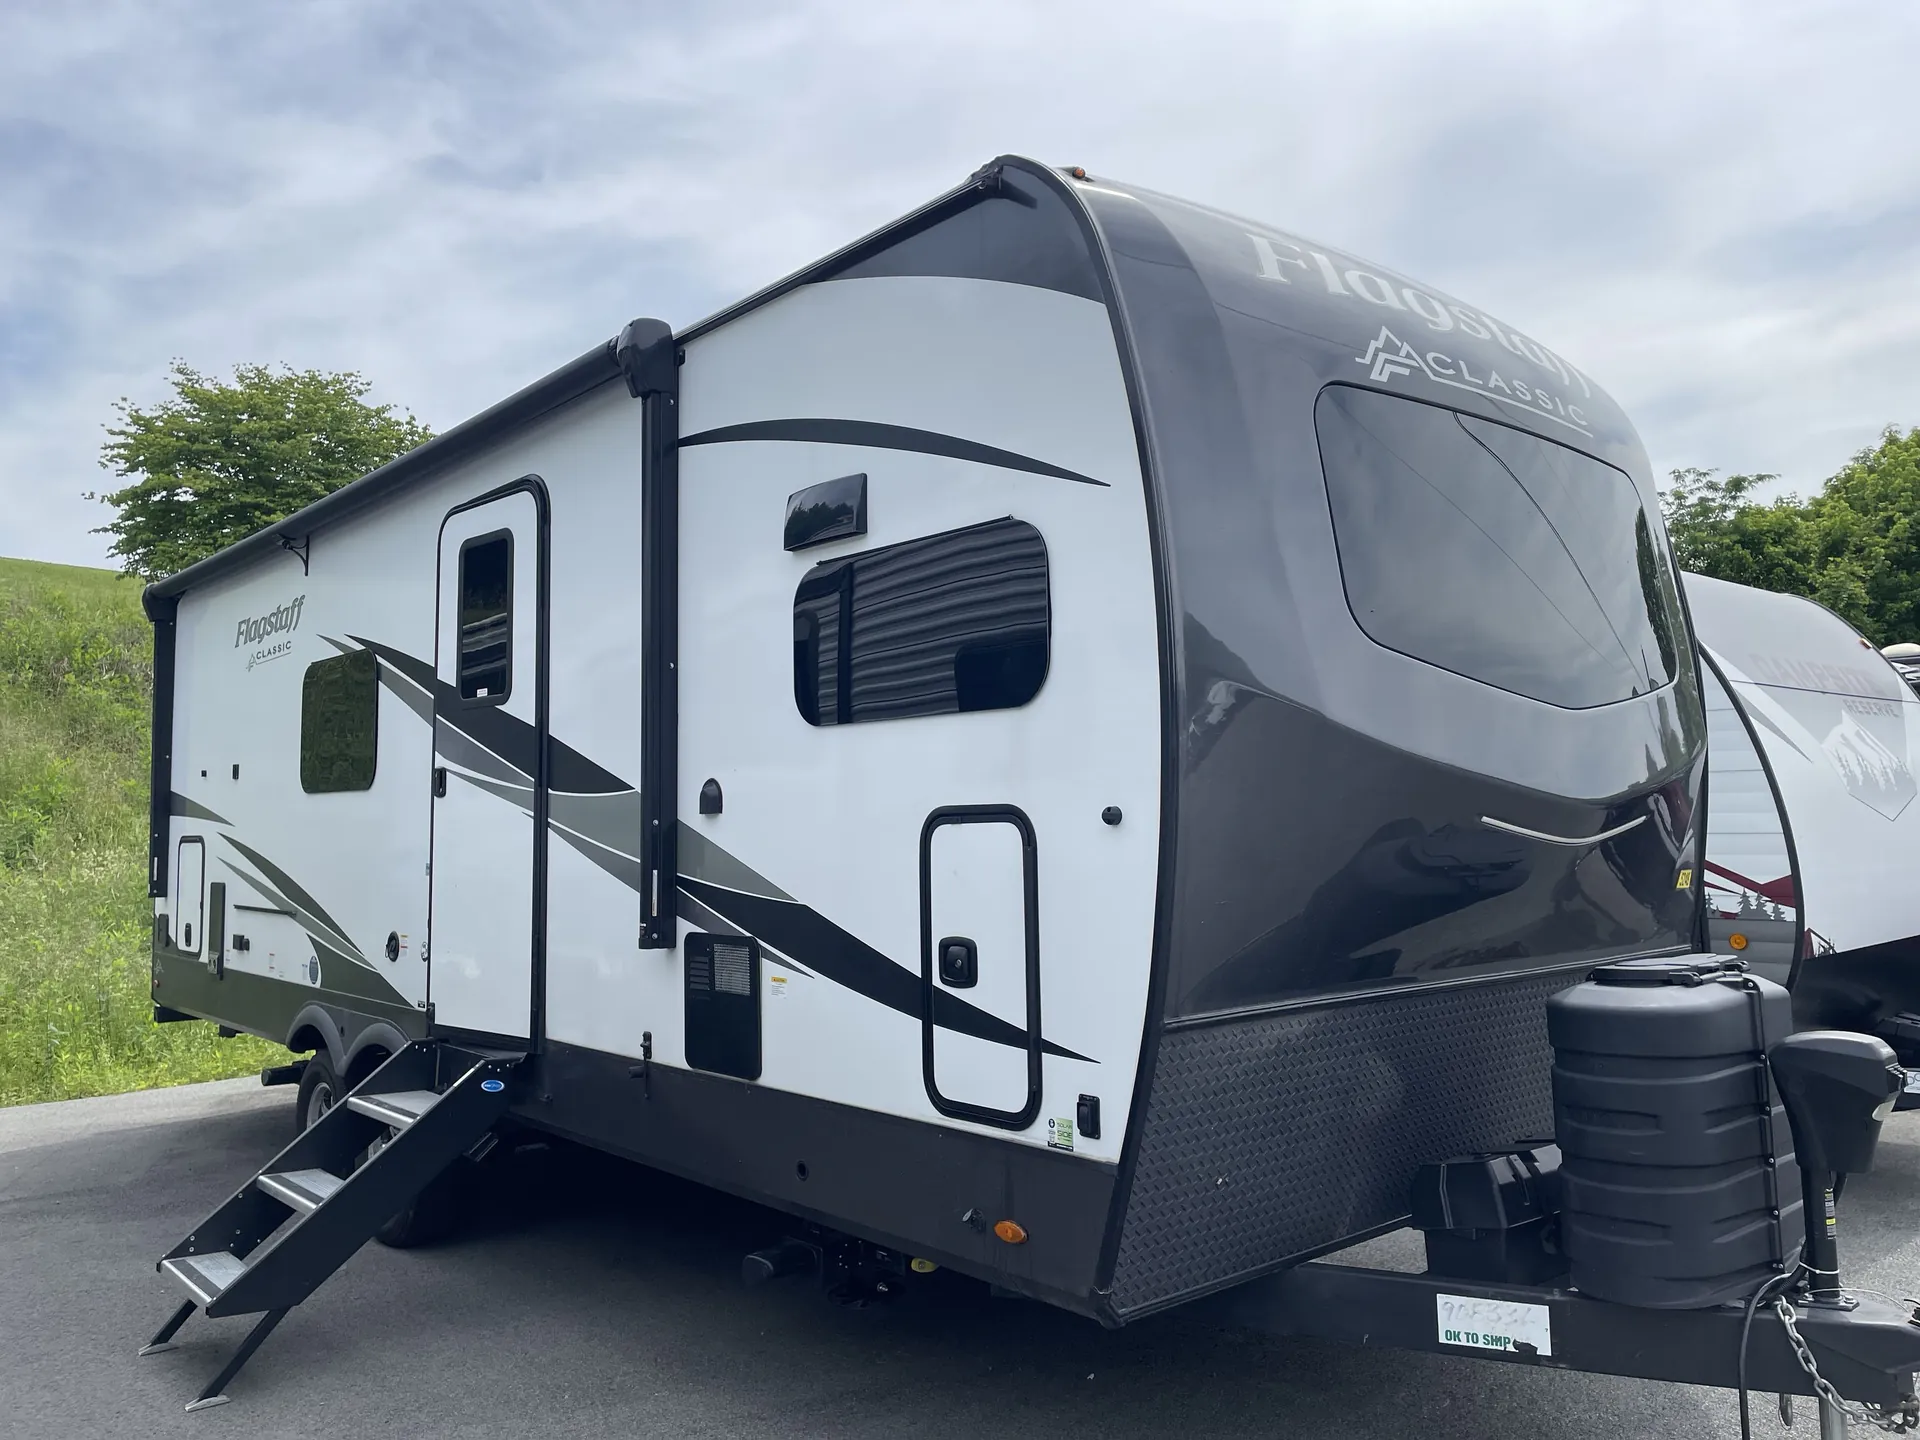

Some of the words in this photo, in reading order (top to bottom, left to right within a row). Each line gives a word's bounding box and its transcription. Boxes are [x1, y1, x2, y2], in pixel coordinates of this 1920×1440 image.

[1425, 351, 1588, 426] CLASSIC
[234, 594, 306, 648] Flagstaff
[256, 640, 292, 660] CLASSIC
[1843, 698, 1899, 718] RESERVE
[1444, 1329, 1462, 1343] OK
[1464, 1331, 1479, 1345] TO
[1482, 1333, 1511, 1348] SHIP
